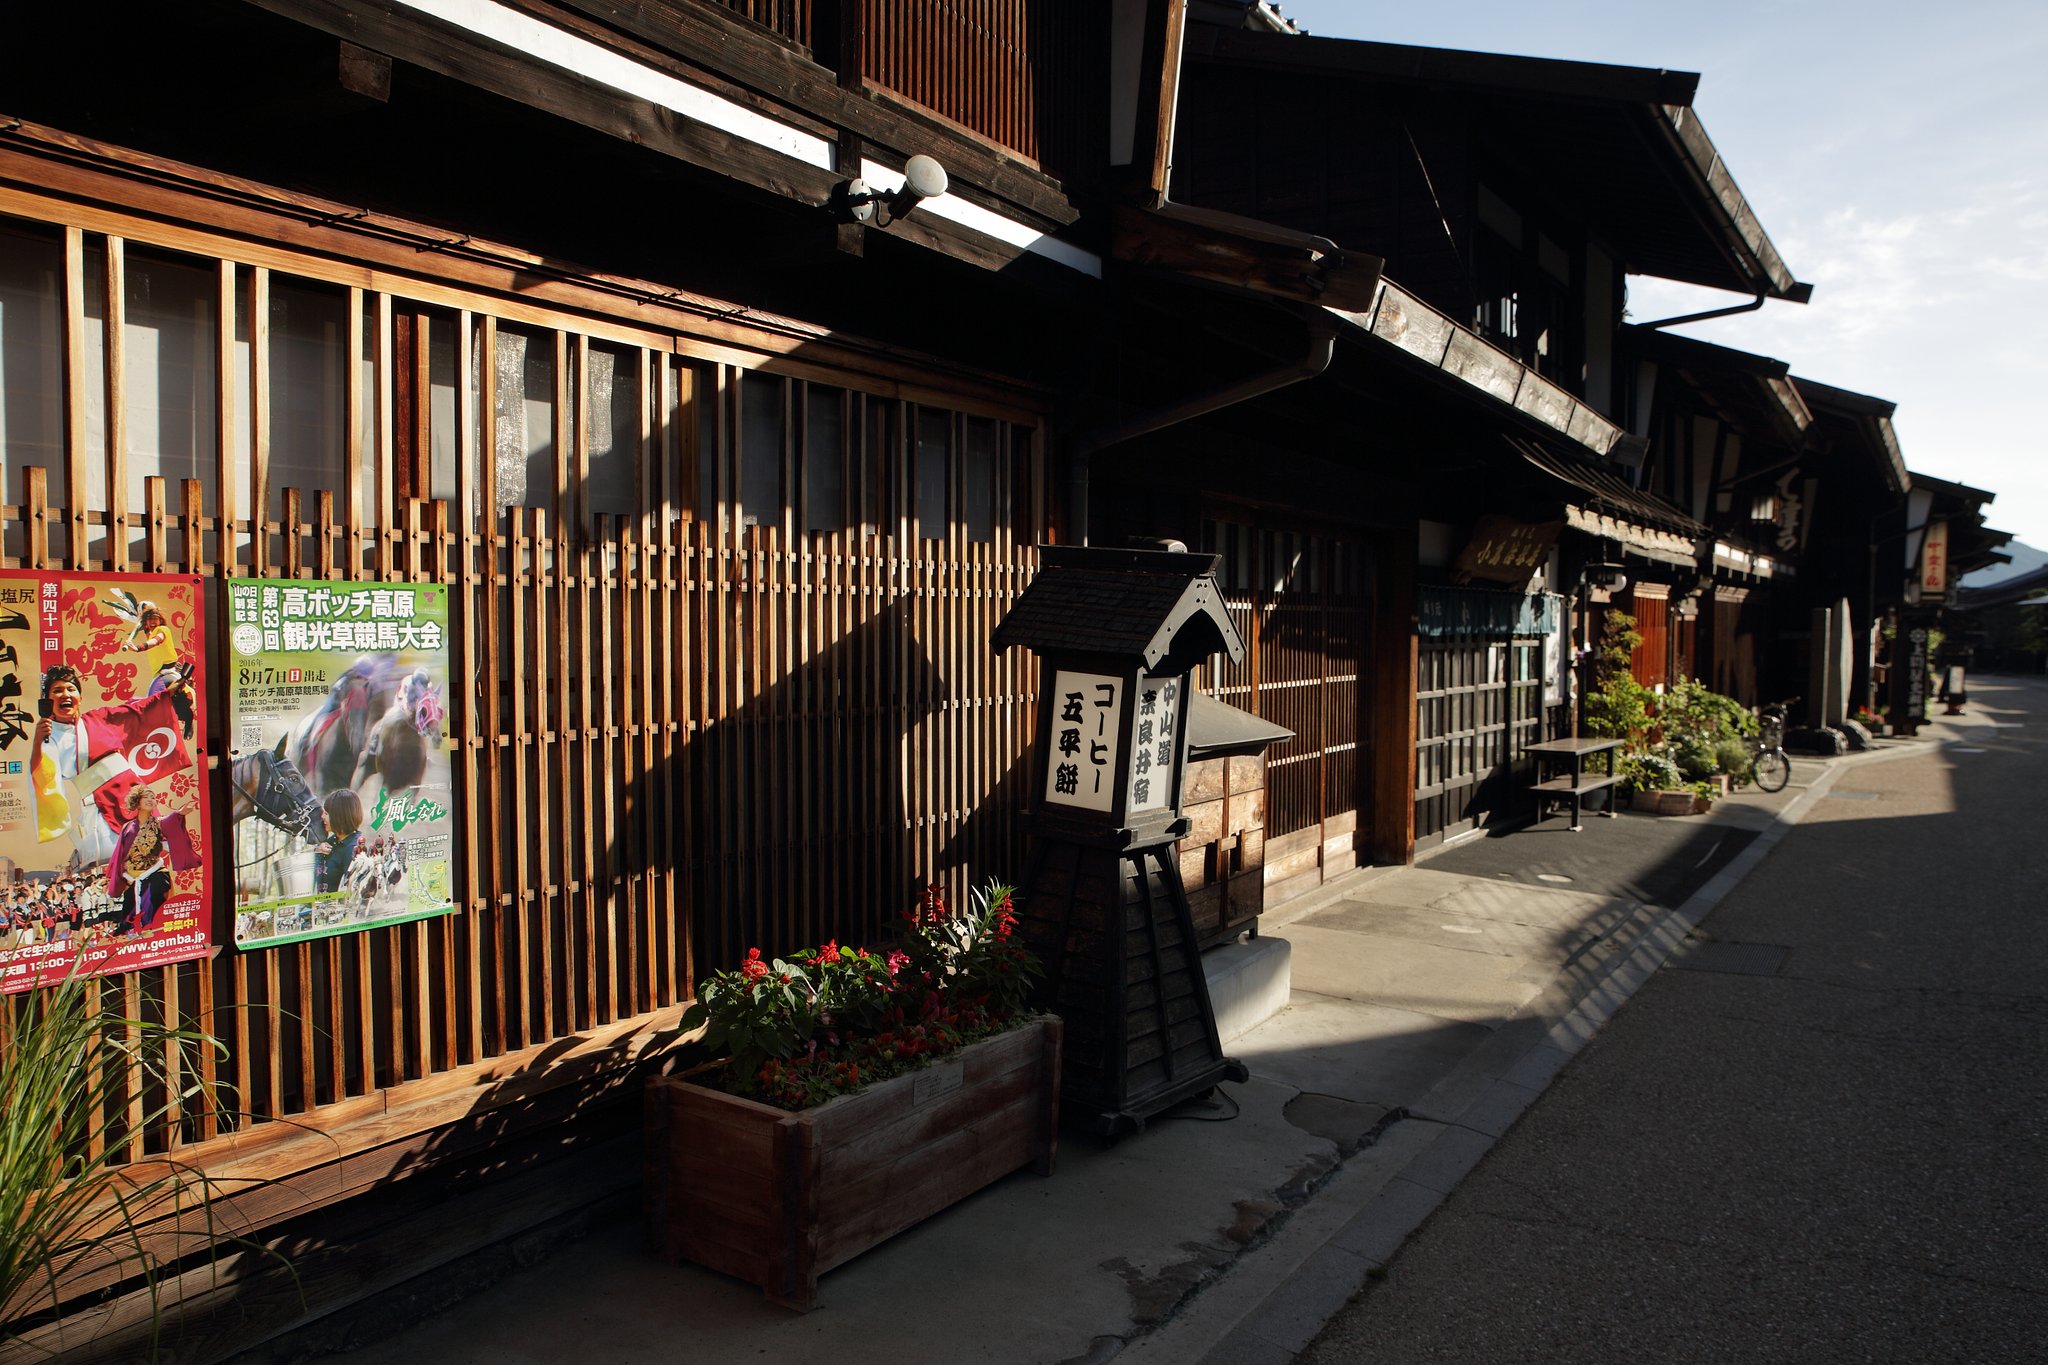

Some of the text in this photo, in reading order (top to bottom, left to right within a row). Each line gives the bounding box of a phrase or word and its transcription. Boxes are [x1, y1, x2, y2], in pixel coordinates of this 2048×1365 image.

[1, 589, 35, 604] 塩尻
[234, 586, 257, 597] 山の日
[235, 598, 258, 609] 制定
[282, 587, 416, 618] 高ボッチ高原
[42, 582, 59, 652] 第四十一回
[235, 611, 258, 621] 記念
[262, 586, 280, 651] 第63回
[283, 621, 442, 650] 観光草競馬大会
[239, 658, 263, 667] 2016年
[239, 685, 329, 697] 高ボッチ高原草競馬場
[1157, 680, 1177, 767] 中山道
[1054, 691, 1084, 796] 五平餅
[1090, 683, 1115, 794] コーヒー
[1134, 689, 1157, 805] 奈良井宿
[382, 796, 442, 825] 風となれ
[116, 931, 206, 955] www.gemba.jp
